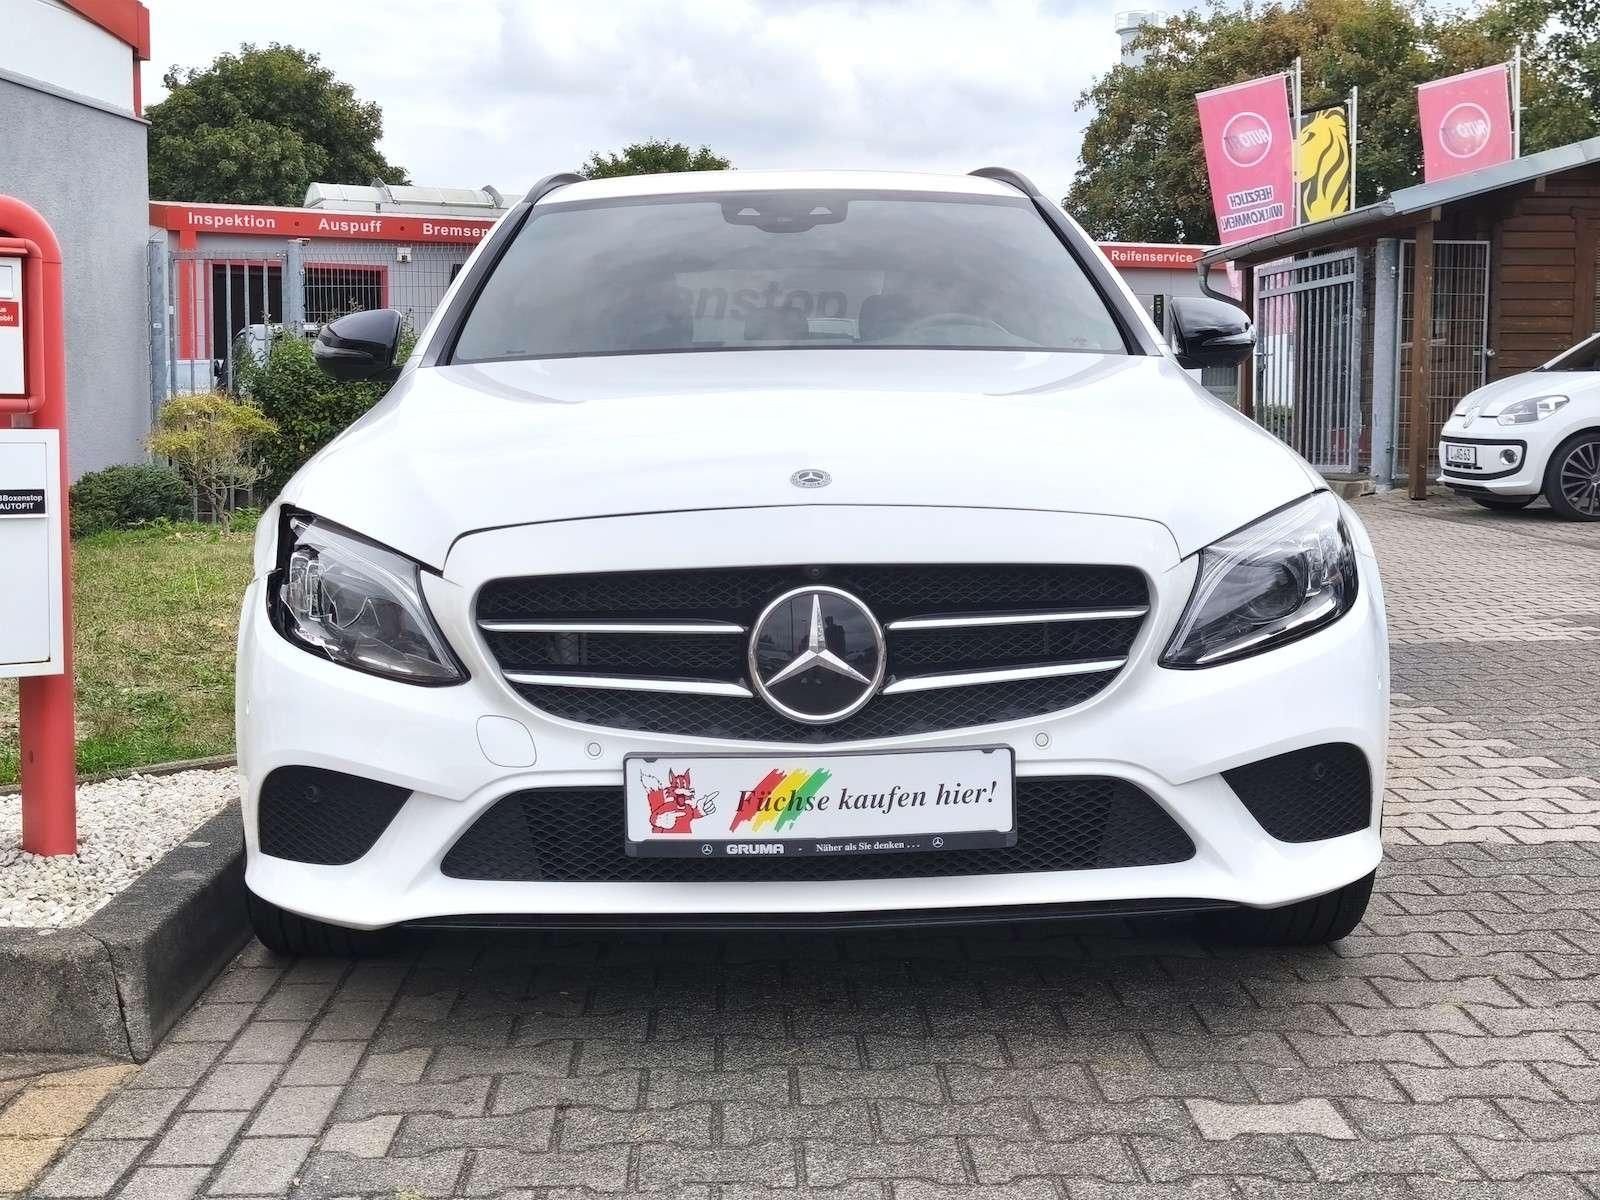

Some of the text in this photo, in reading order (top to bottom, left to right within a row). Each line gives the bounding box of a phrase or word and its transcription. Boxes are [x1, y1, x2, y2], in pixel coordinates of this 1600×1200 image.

[188, 211, 276, 230] Inspektion
[318, 217, 382, 234] Auspuff
[1111, 250, 1193, 263] Reifenservice
[0, 502, 34, 510] AUTOFIT
[736, 781, 998, 815] Füchse kaufen hier!
[726, 844, 785, 855] GRUMA
[815, 843, 842, 852] Näher
[844, 842, 858, 851] als
[858, 841, 872, 851] Sie
[873, 840, 905, 850] denken
